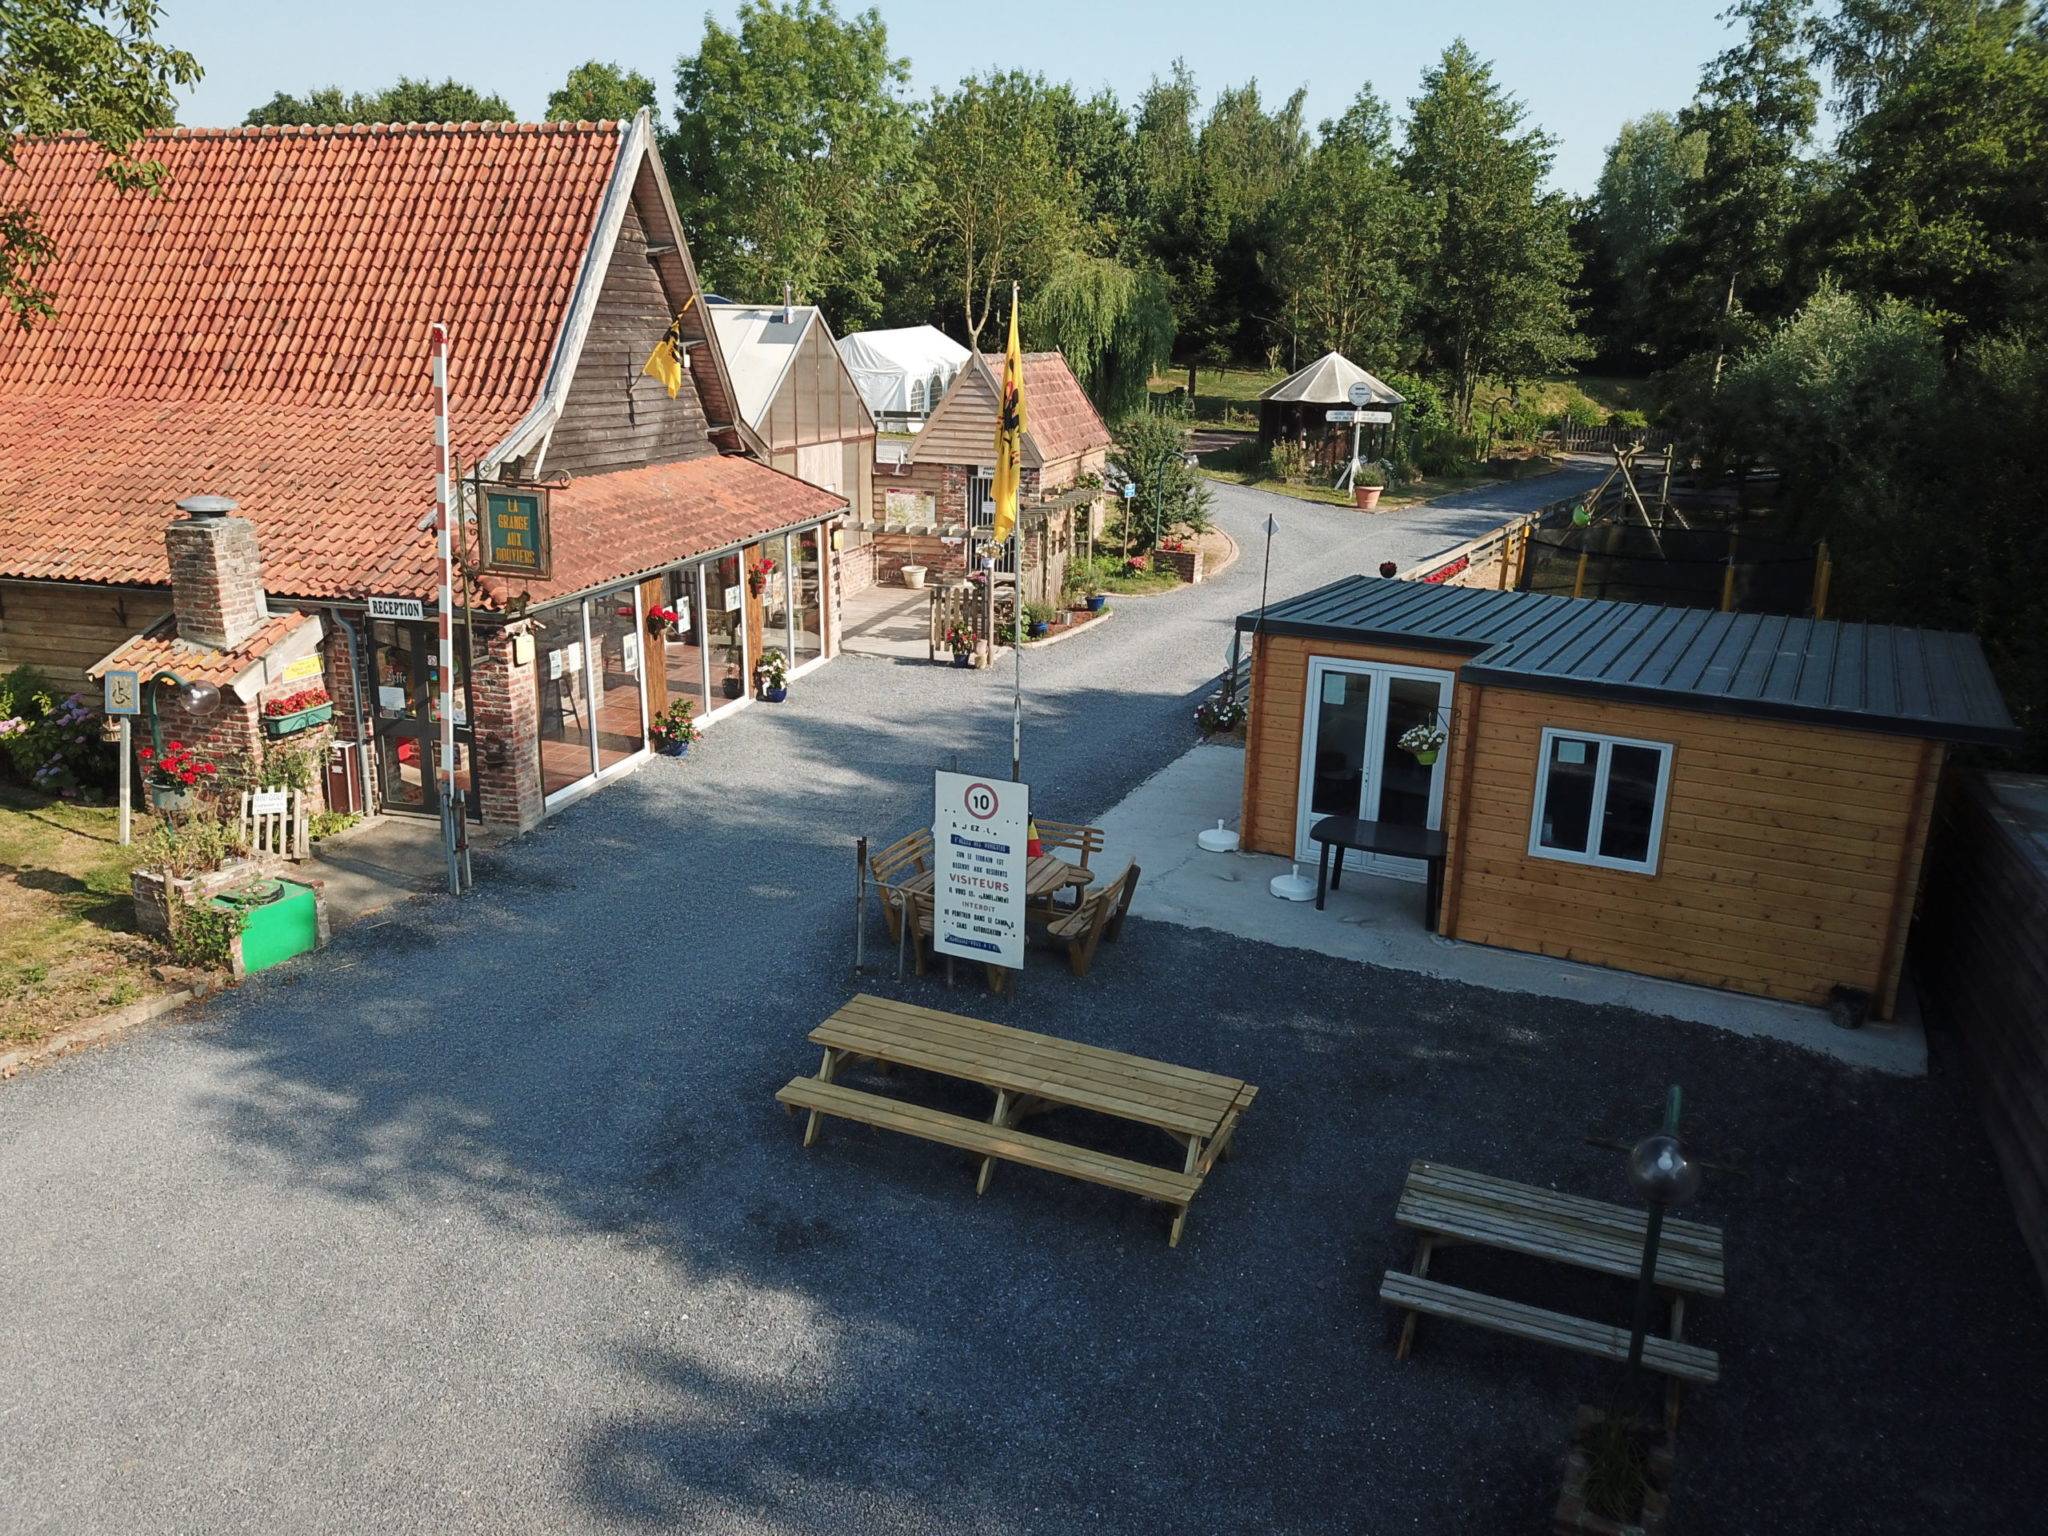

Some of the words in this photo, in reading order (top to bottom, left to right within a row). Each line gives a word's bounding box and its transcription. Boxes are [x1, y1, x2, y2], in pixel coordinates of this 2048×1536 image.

[507, 499, 518, 512] LA
[498, 514, 529, 530] GRANGE
[507, 531, 523, 546] AUX
[372, 600, 420, 617] RECEPTION
[973, 795, 989, 810] 10
[950, 873, 1009, 892] VISITEURS
[962, 901, 995, 912] INTERDIT
